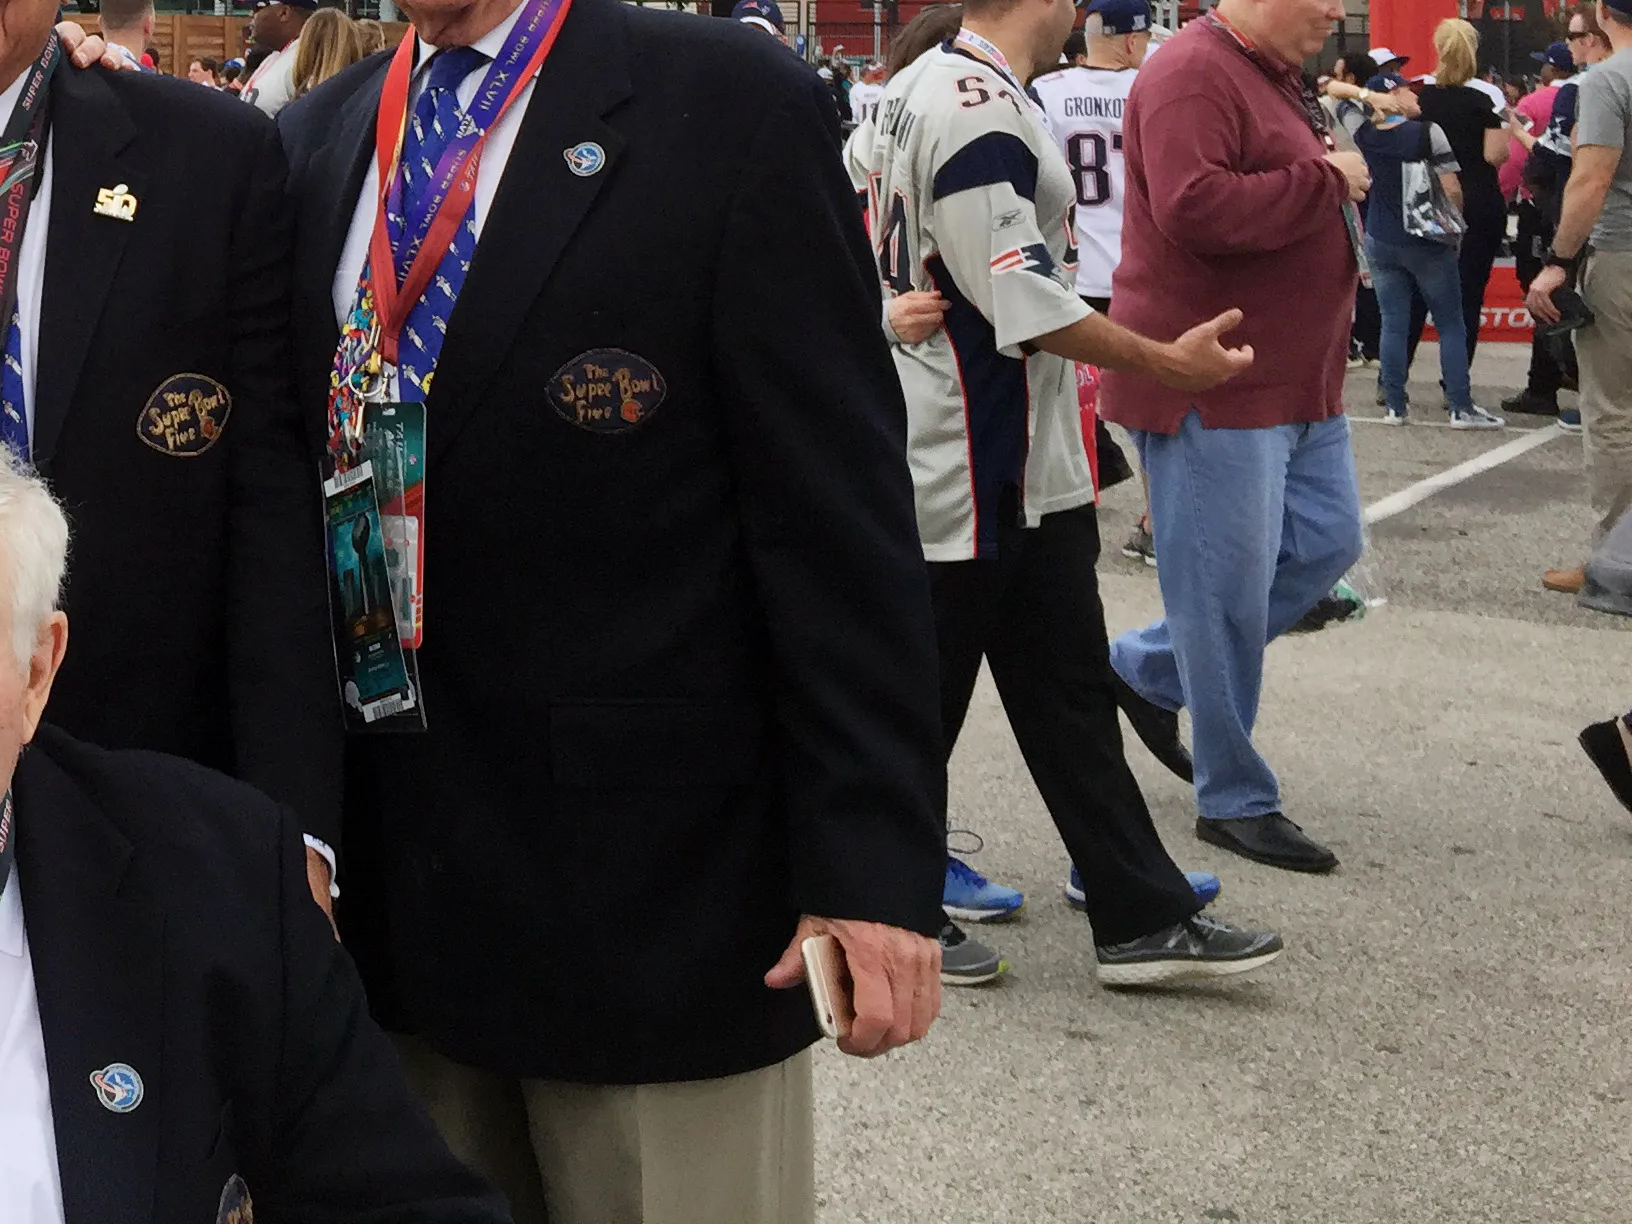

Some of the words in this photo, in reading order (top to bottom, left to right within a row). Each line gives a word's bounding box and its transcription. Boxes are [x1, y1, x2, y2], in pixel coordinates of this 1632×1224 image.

[506, 35, 529, 66] BOWL
[22, 70, 44, 111] SUPER
[479, 70, 510, 111] XLVII
[1, 183, 24, 243] SUPER
[560, 374, 612, 403] Super
[612, 367, 661, 401] Bowl
[583, 364, 609, 379] The
[149, 406, 191, 435] Super
[189, 388, 226, 418] Bowl
[163, 392, 187, 407] The
[575, 399, 613, 423] Five
[165, 427, 196, 450] Five
